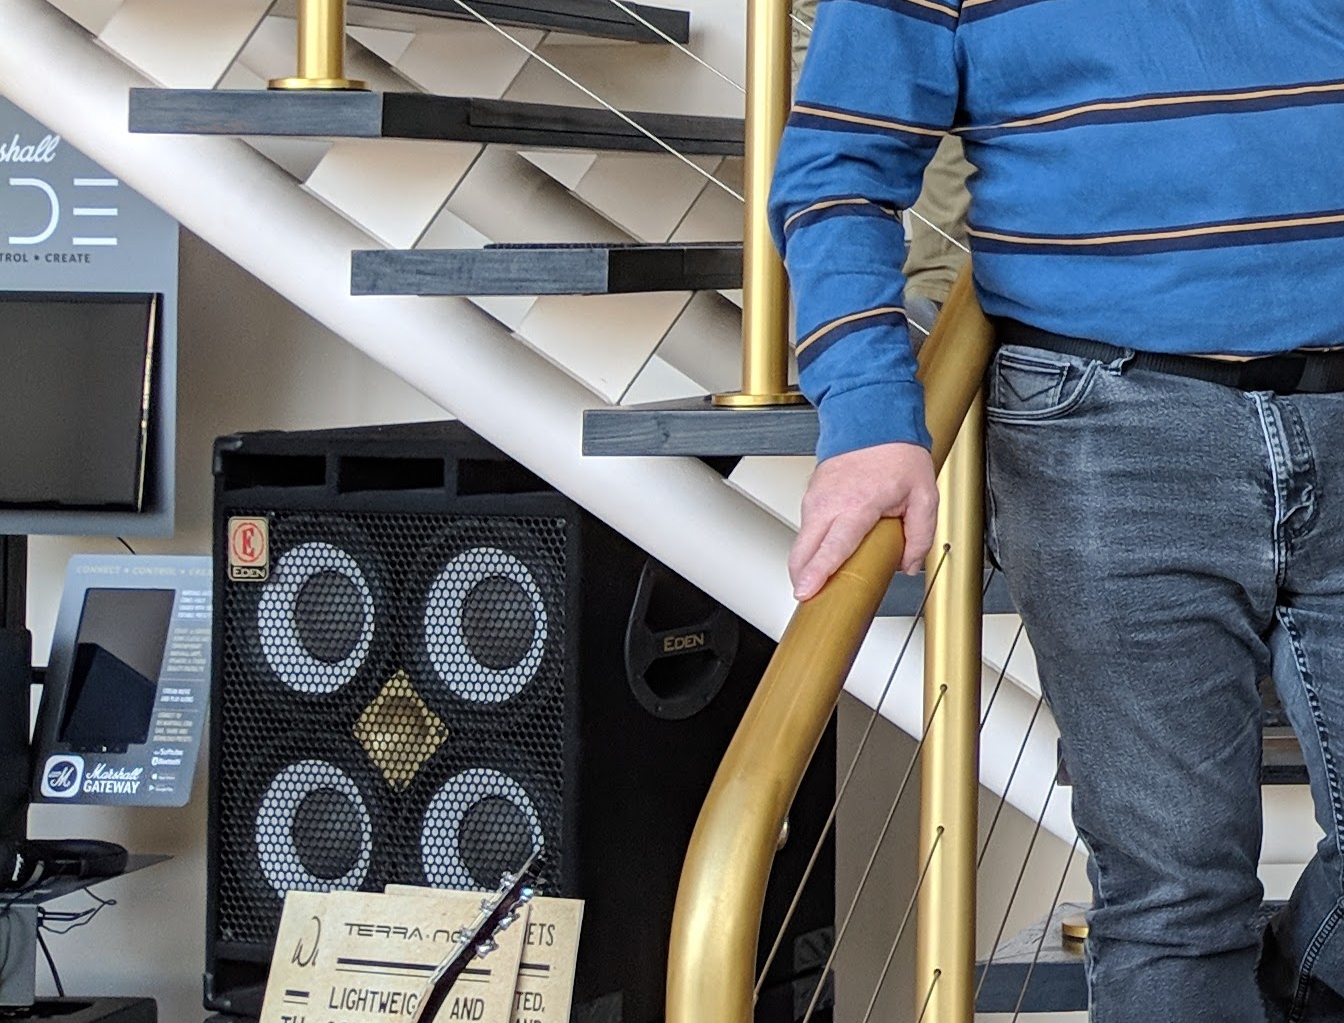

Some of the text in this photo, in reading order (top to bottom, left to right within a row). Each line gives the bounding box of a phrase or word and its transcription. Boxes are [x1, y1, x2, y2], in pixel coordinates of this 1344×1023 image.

[0, 133, 60, 163] shall
[8, 178, 118, 245] DE
[45, 253, 91, 263] CREATE
[232, 566, 265, 578] EDEN
[663, 633, 705, 652] EDEN
[86, 762, 143, 780] Marshall
[83, 779, 140, 793] GATEWAY
[526, 922, 555, 946] ETS
[328, 986, 485, 1021] LIGHTWEIG AND
